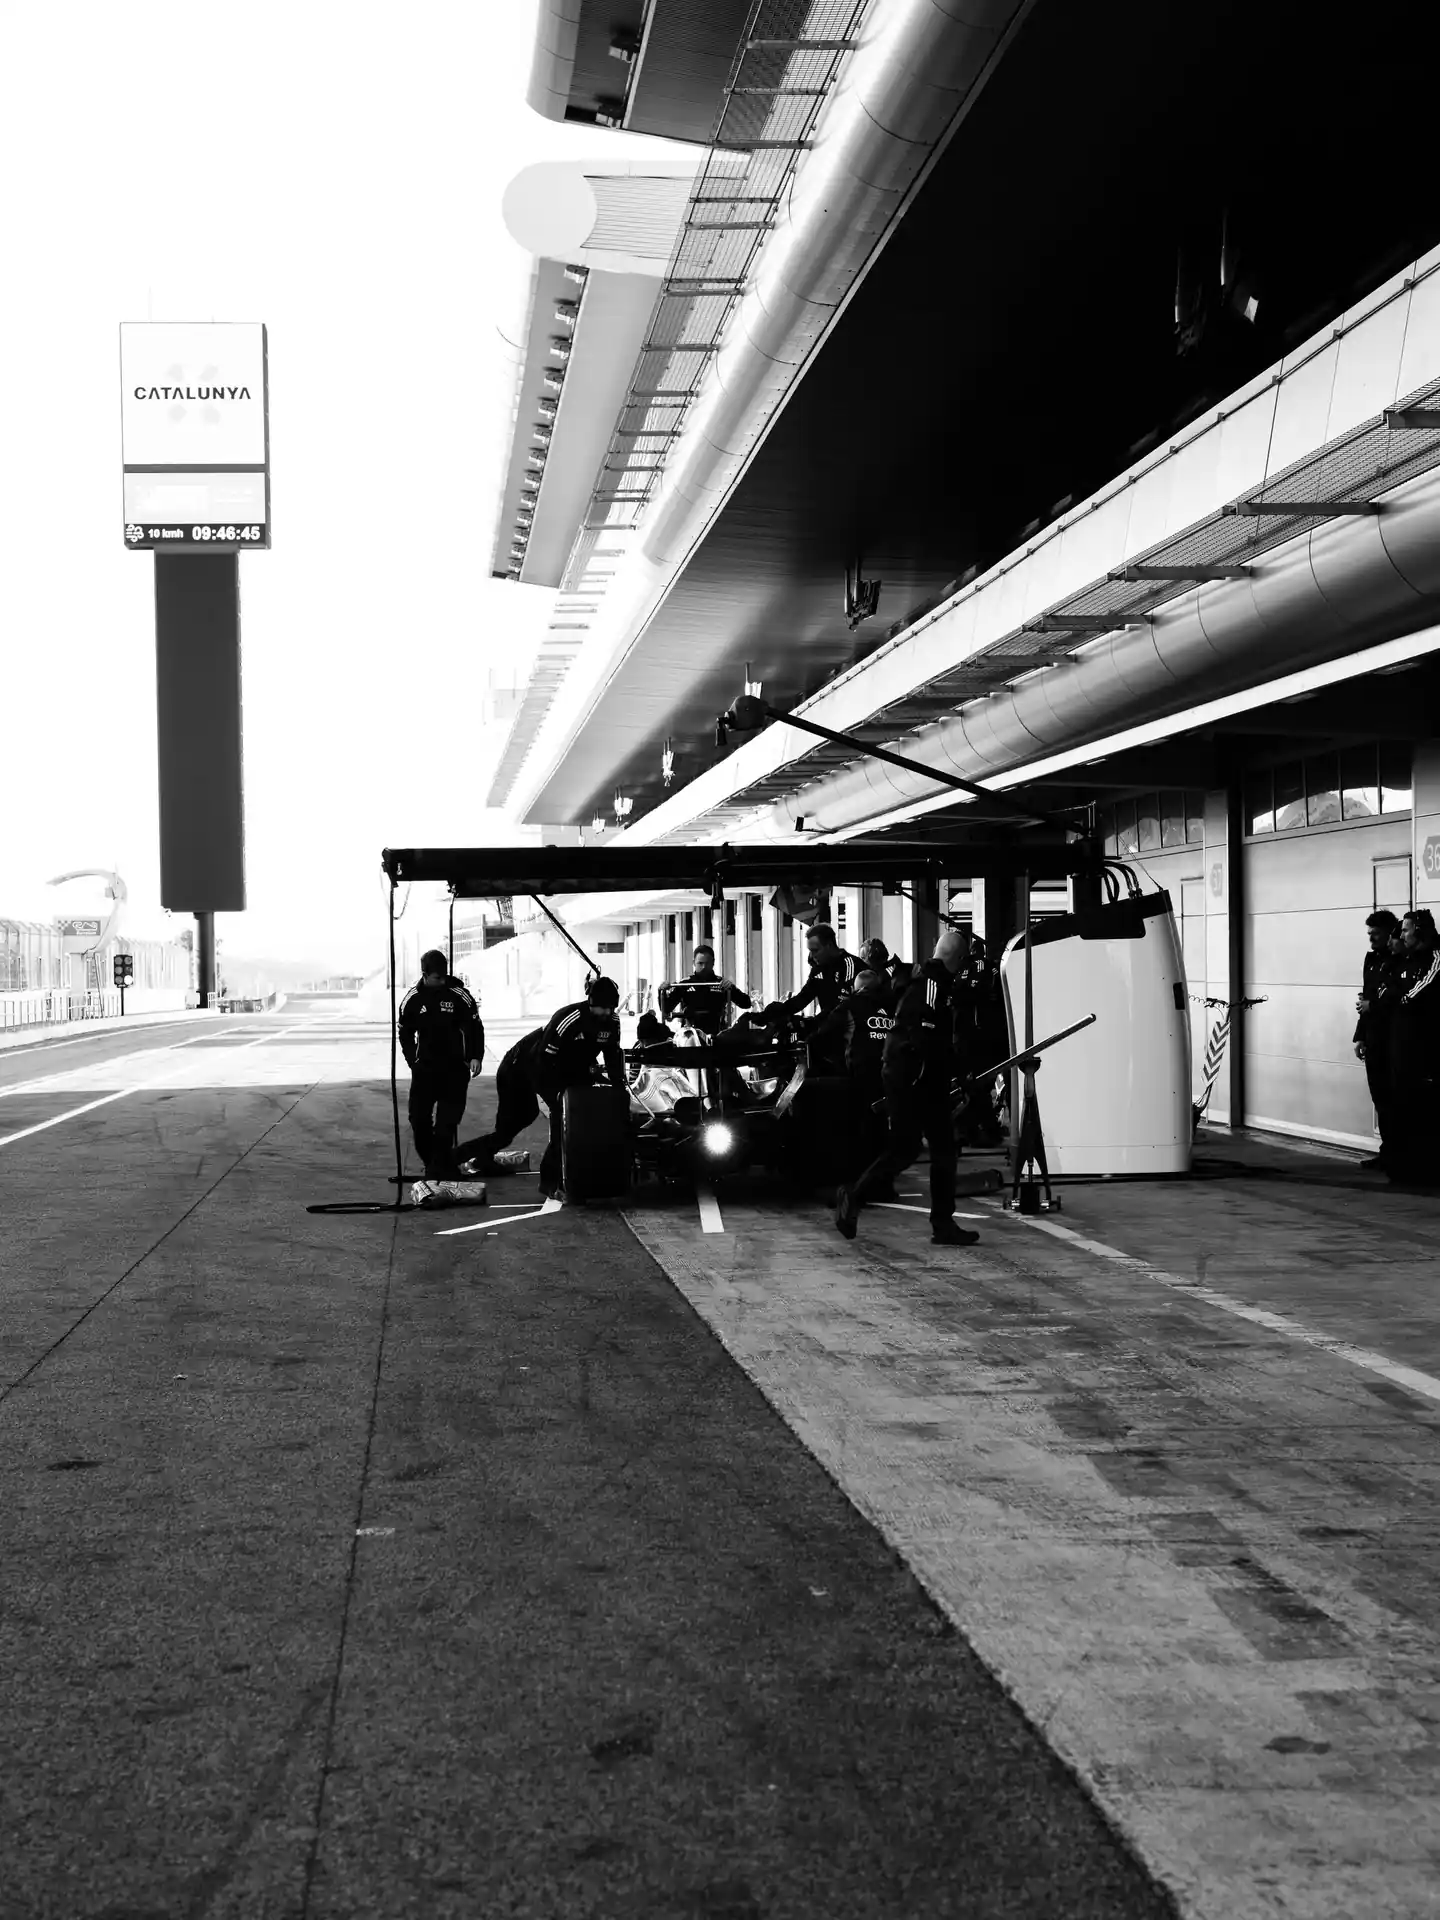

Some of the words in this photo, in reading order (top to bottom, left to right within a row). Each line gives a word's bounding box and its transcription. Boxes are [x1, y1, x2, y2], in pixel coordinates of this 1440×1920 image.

[134, 387, 251, 400] CATALUNYA
[148, 528, 160, 538] 10
[192, 526, 260, 540] 09:46:45
